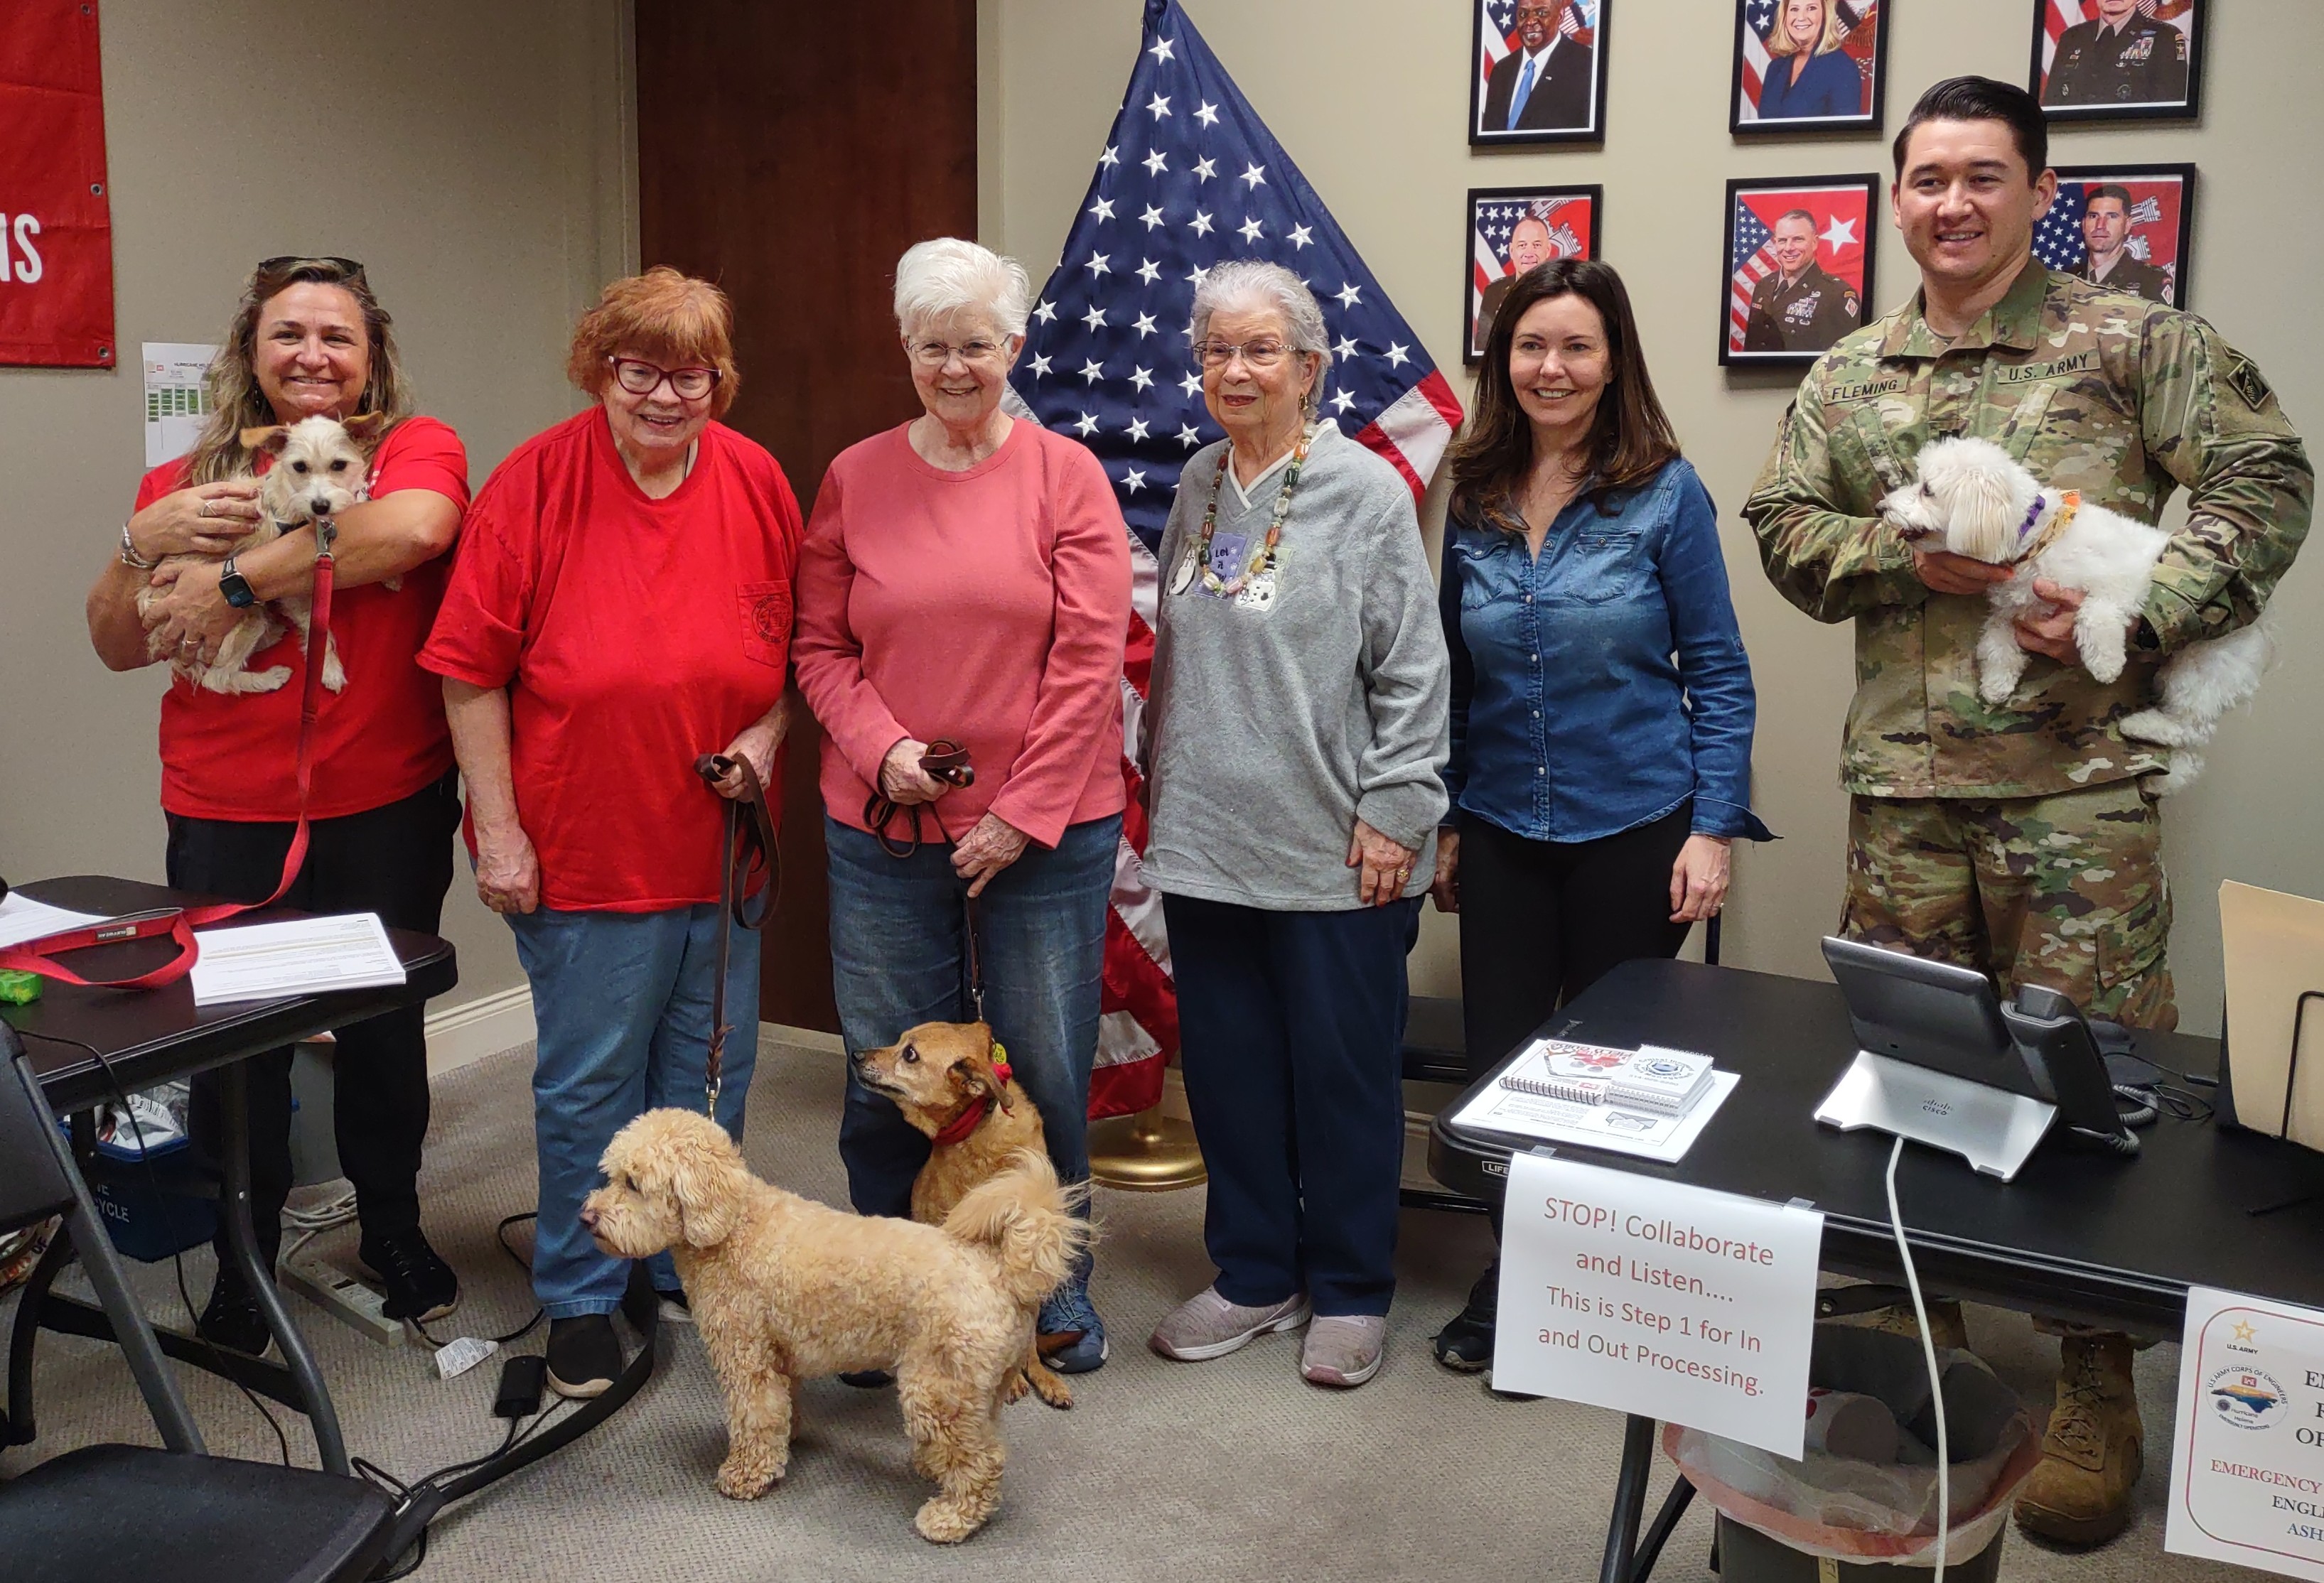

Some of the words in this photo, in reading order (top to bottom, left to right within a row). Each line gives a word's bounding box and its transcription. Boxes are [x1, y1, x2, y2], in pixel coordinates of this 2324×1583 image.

[2008, 365, 2038, 382] U.S.
[2045, 354, 2089, 377] ARMY
[1832, 379, 1898, 400] FLEMING
[1544, 1197, 1616, 1232] STOP!
[1625, 1215, 1774, 1265] Collaborate
[1576, 1253, 1621, 1277] and
[1631, 1259, 1733, 1302] Listen....
[1546, 1285, 1591, 1312] This
[1598, 1297, 1614, 1318] is
[1621, 1303, 1671, 1334] Step
[1679, 1317, 1691, 1336] 1
[1699, 1319, 1733, 1345] for
[1741, 1329, 1760, 1353] In
[1539, 1329, 1579, 1349] and
[1588, 1334, 1629, 1361] Out
[1637, 1344, 1764, 1397] Processing.
[2239, 1346, 2259, 1355] ARMY
[2214, 1367, 2230, 1381] ARMY
[2263, 1374, 2288, 1405] ENGINEERS
[2210, 1459, 2323, 1494] EMERGENCY
